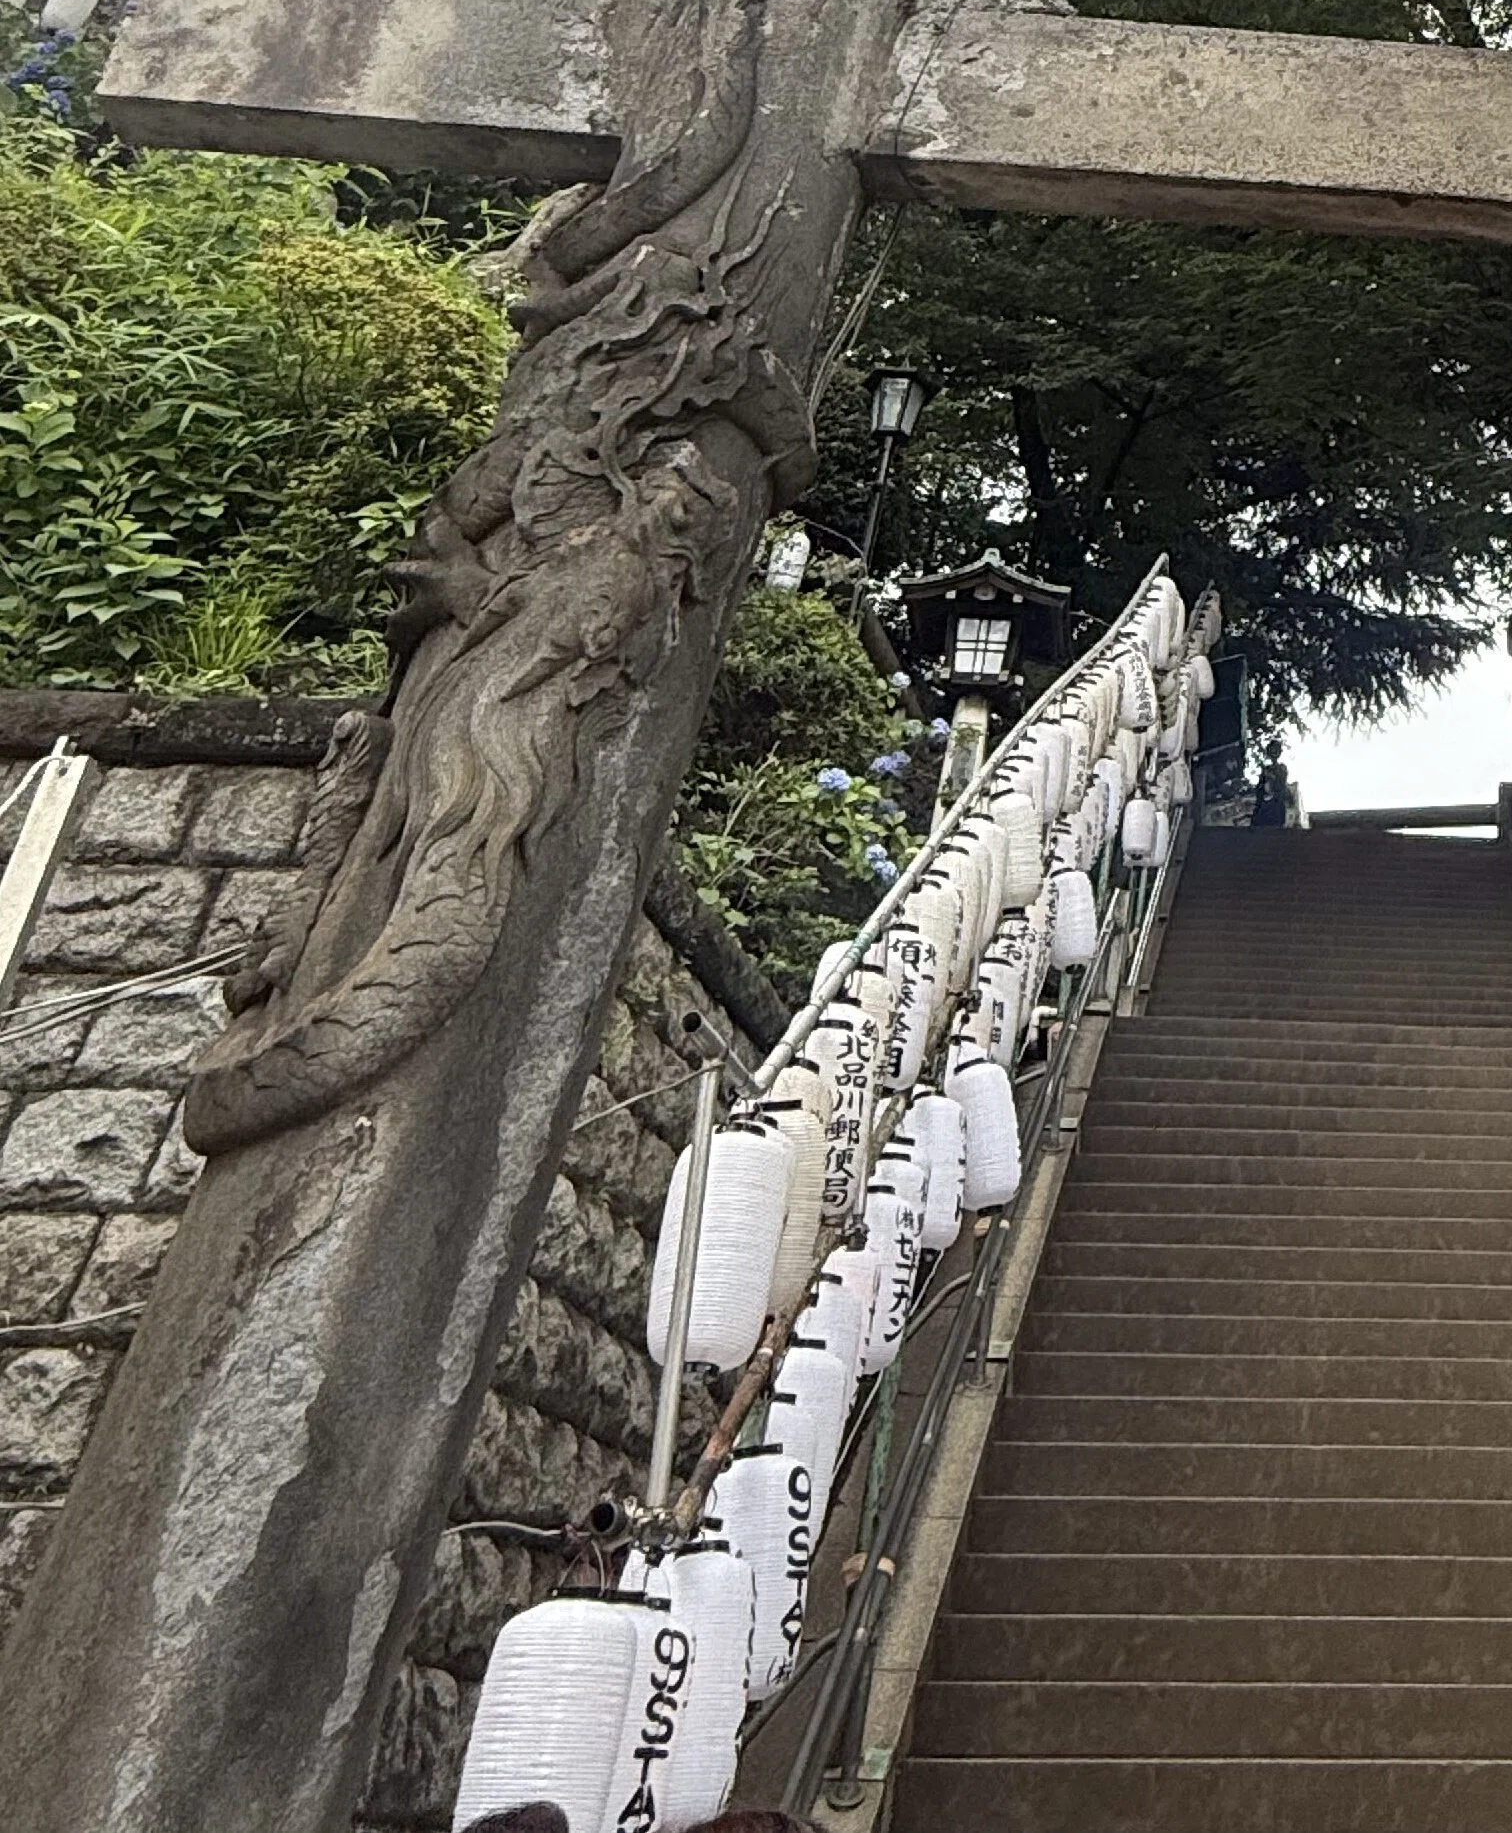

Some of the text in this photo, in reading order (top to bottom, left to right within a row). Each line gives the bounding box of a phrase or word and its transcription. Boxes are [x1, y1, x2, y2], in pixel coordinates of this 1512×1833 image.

[822, 1034, 870, 1208] 北品川郵便局
